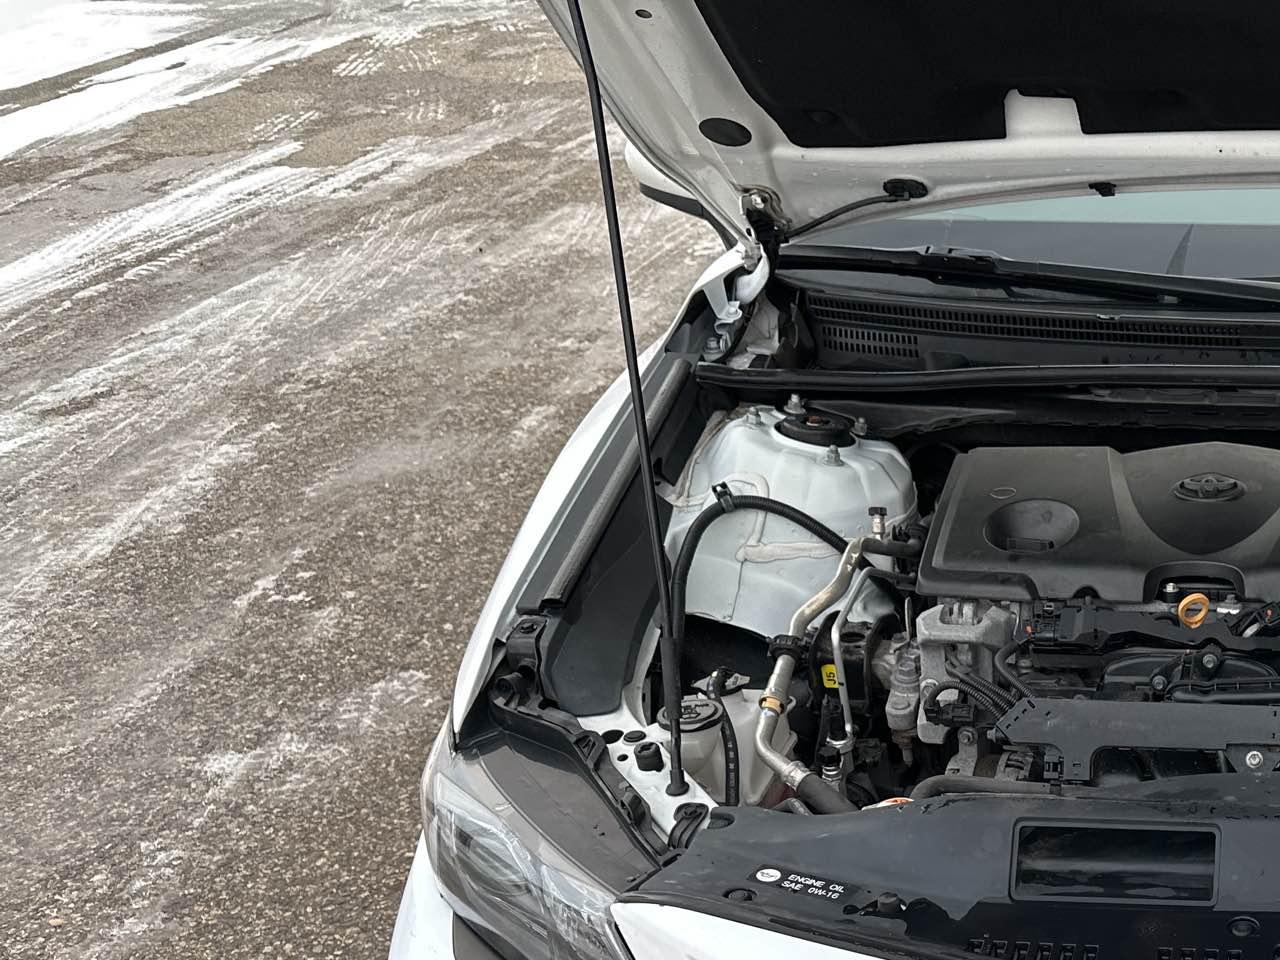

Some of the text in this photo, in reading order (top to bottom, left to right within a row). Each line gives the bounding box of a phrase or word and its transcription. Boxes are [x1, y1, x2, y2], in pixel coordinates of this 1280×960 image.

[781, 880, 840, 899] SAE 0W-16
[787, 874, 845, 893] ENGINE OIL
